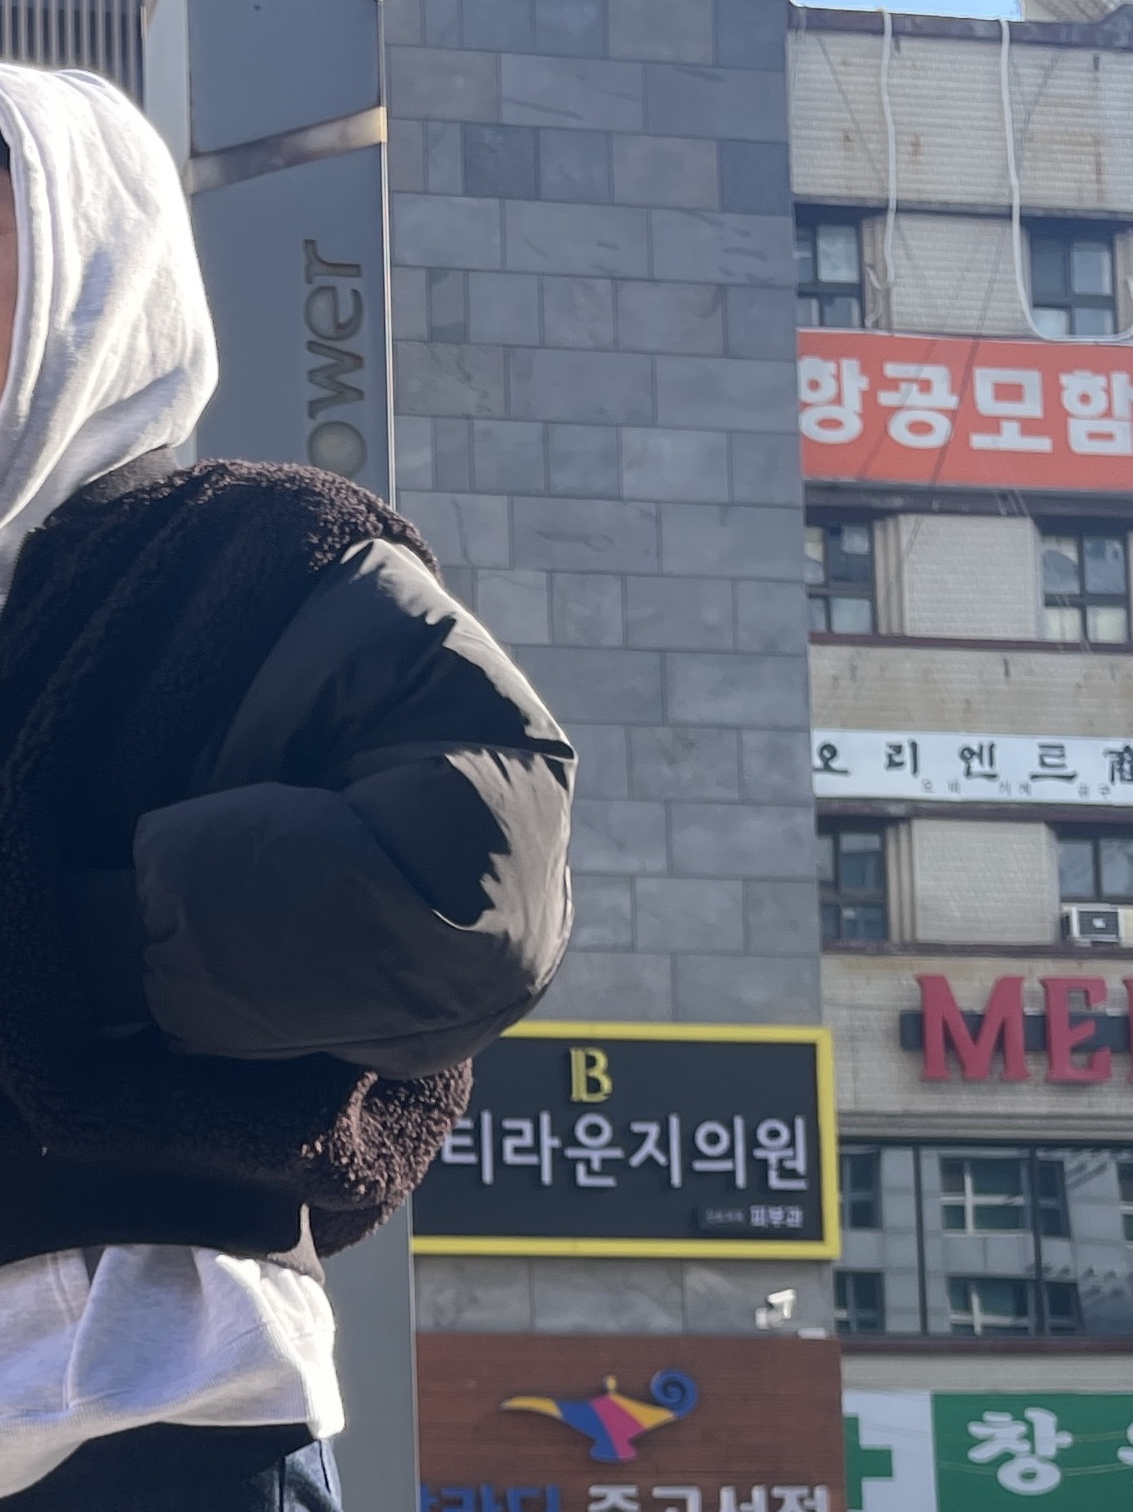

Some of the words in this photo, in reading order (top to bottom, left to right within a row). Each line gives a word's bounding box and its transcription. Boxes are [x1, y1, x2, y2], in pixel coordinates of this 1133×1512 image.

[918, 974, 1133, 1083] ME
[569, 1046, 613, 1103] B
[441, 1109, 808, 1190] 티라운지의원
